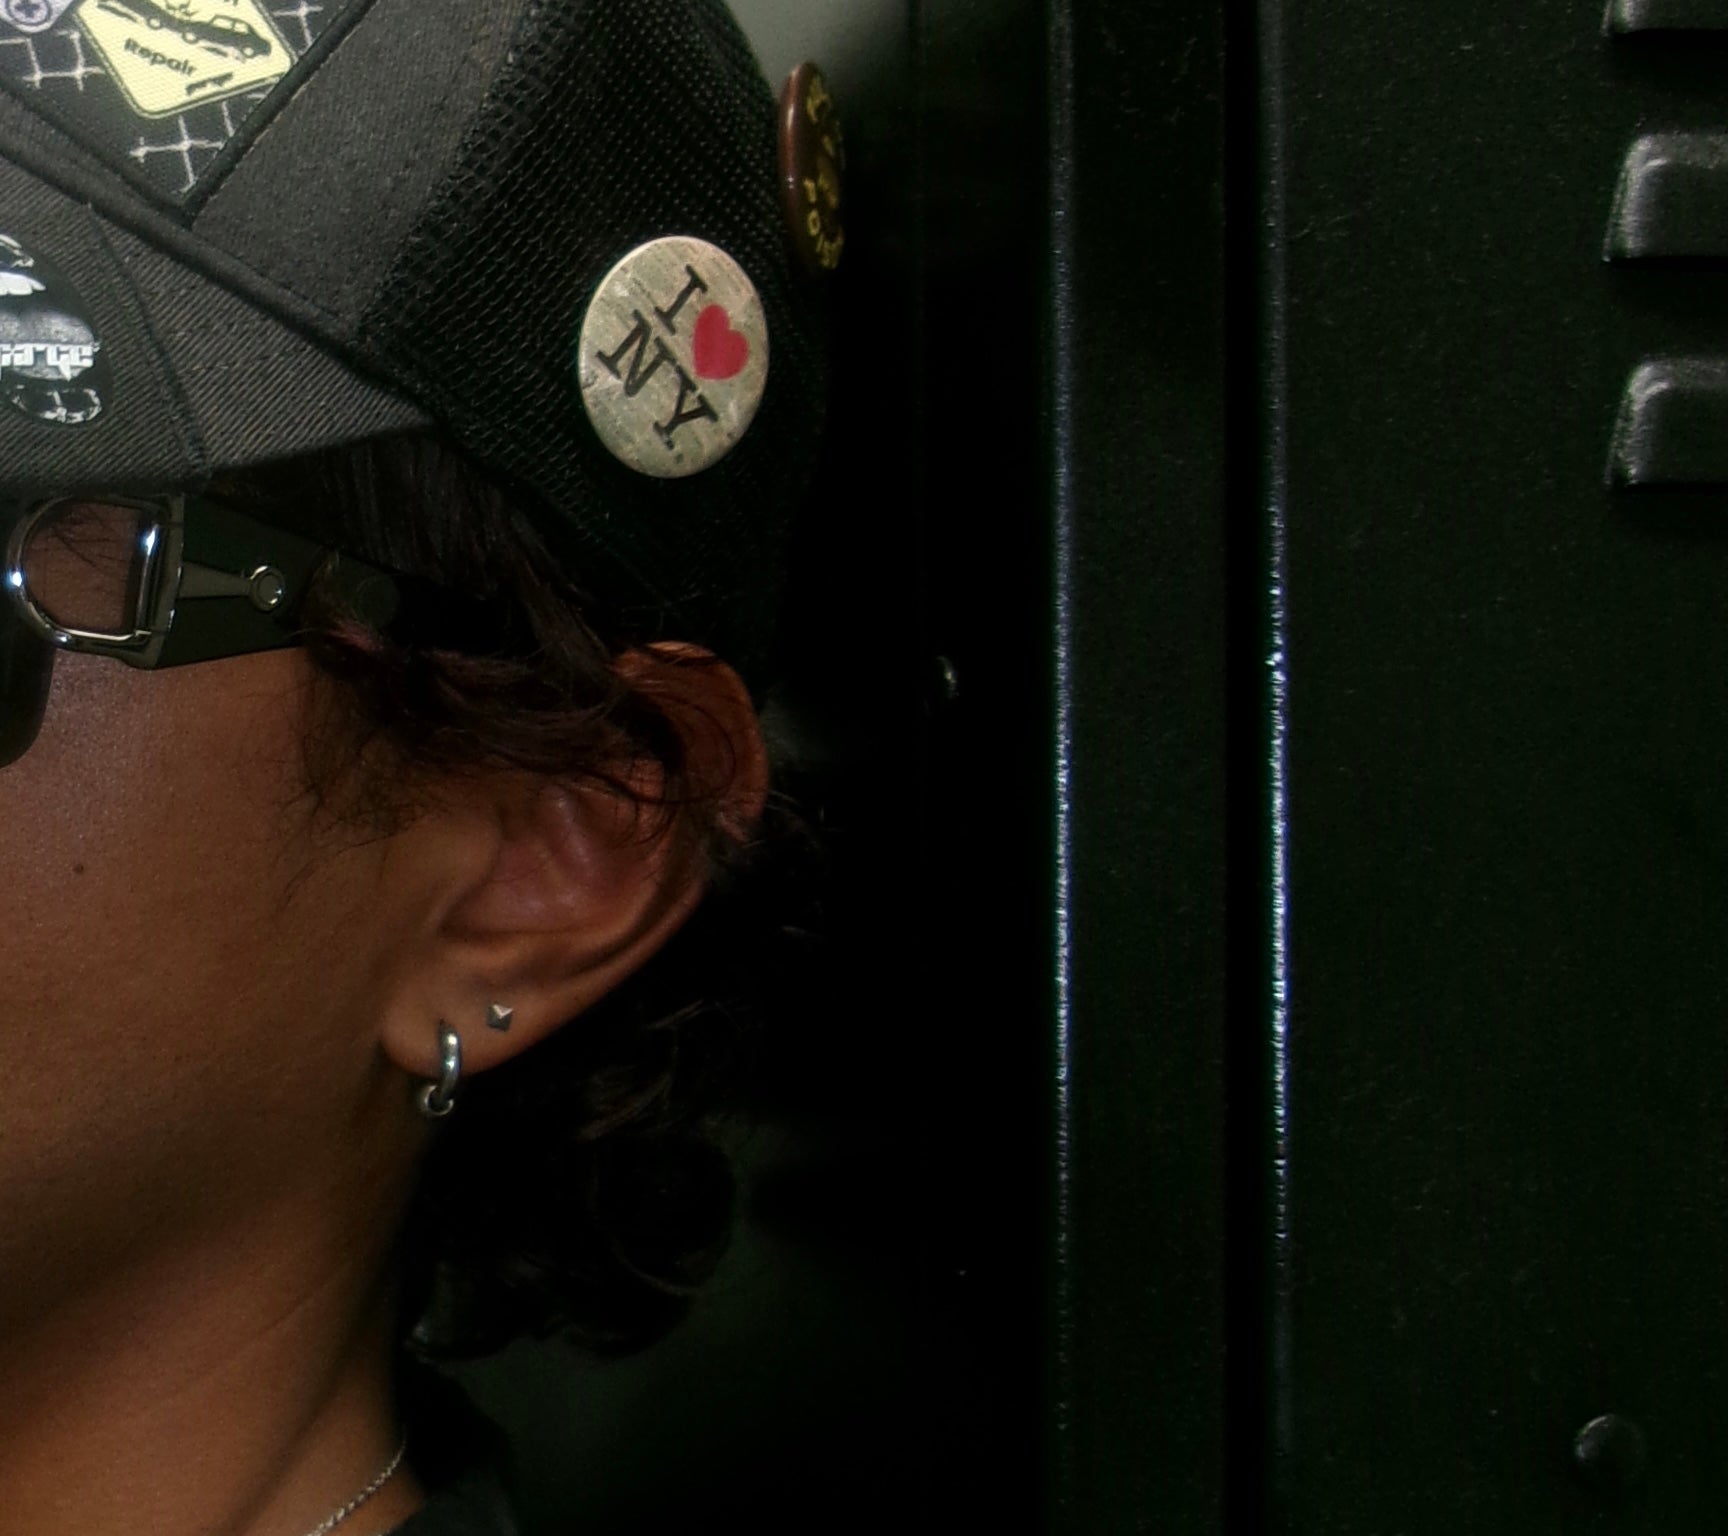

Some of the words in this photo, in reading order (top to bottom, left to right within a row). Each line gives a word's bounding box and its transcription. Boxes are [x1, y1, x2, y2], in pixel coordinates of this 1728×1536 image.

[124, 37, 198, 78] Repair
[655, 264, 708, 336] I
[595, 307, 719, 451] NY
